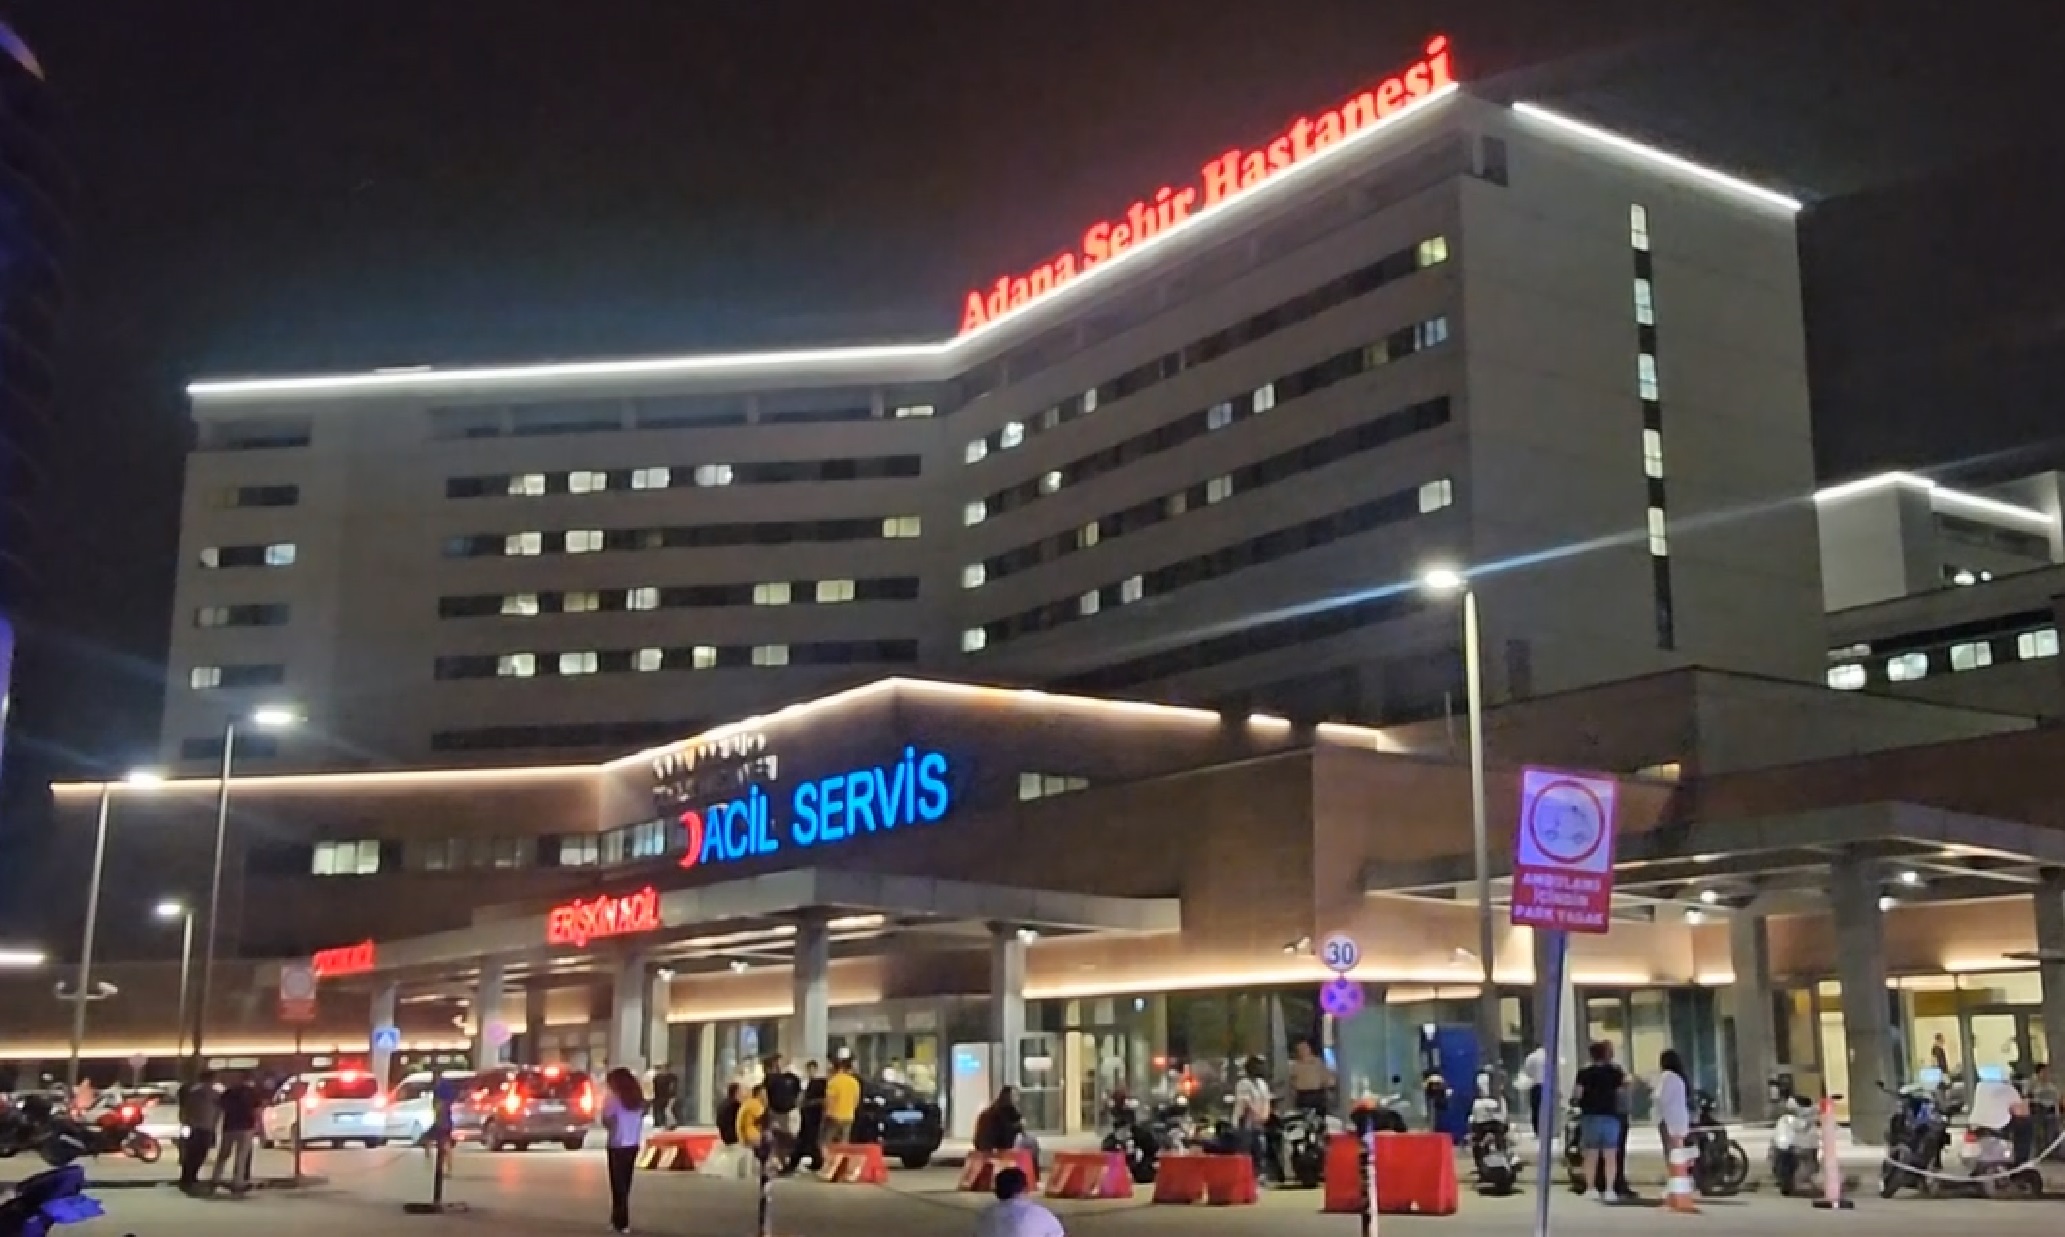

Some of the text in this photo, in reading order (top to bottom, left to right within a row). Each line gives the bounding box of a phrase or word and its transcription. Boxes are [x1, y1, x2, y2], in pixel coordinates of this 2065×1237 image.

[957, 252, 1077, 336] Adana
[1202, 34, 1453, 206] Hastanesi
[700, 783, 779, 865] ACİL
[792, 745, 948, 846] SERVİS
[1327, 941, 1354, 965] 30
